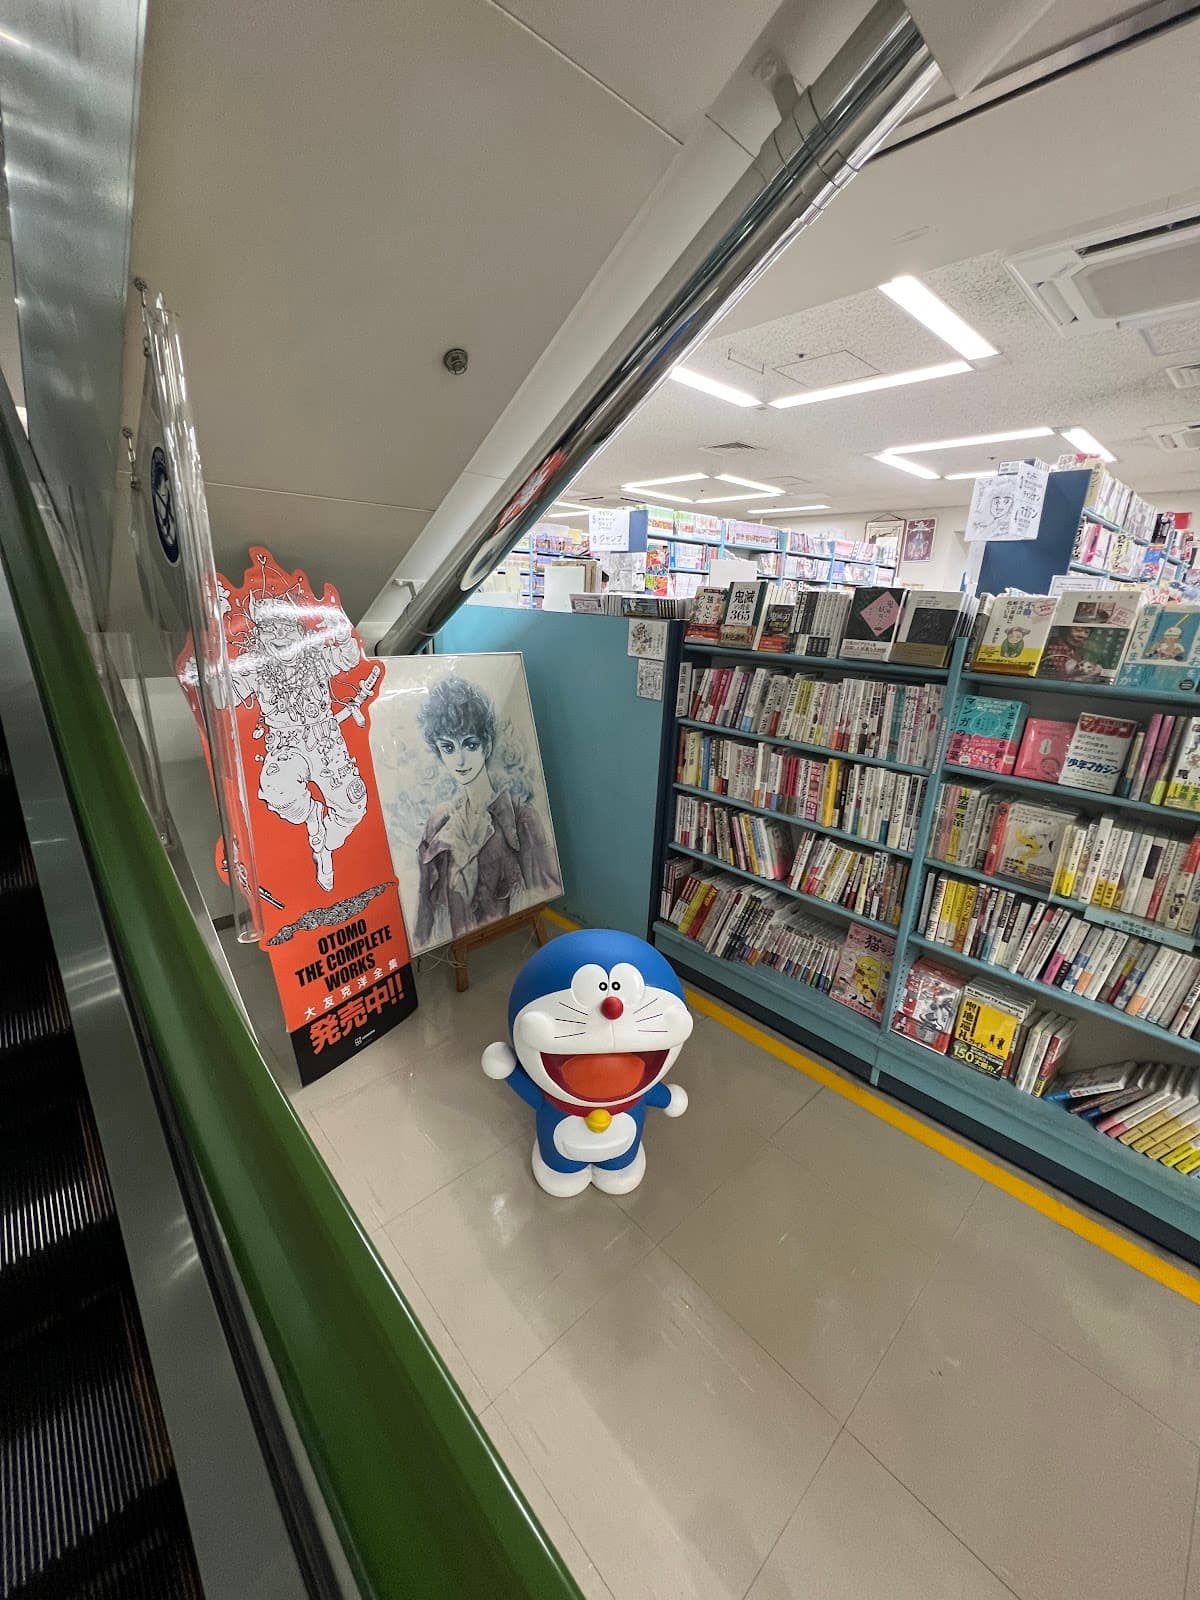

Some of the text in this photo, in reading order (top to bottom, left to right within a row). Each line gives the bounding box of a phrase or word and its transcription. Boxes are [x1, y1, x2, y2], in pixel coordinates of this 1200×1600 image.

[729, 609, 751, 621] 365
[295, 925, 393, 988] THE COMPLETE
[318, 918, 367, 956] OTOMO
[304, 958, 398, 1020] 大友克洋全集
[324, 953, 376, 993] WORKS
[953, 1044, 976, 1063] 150
